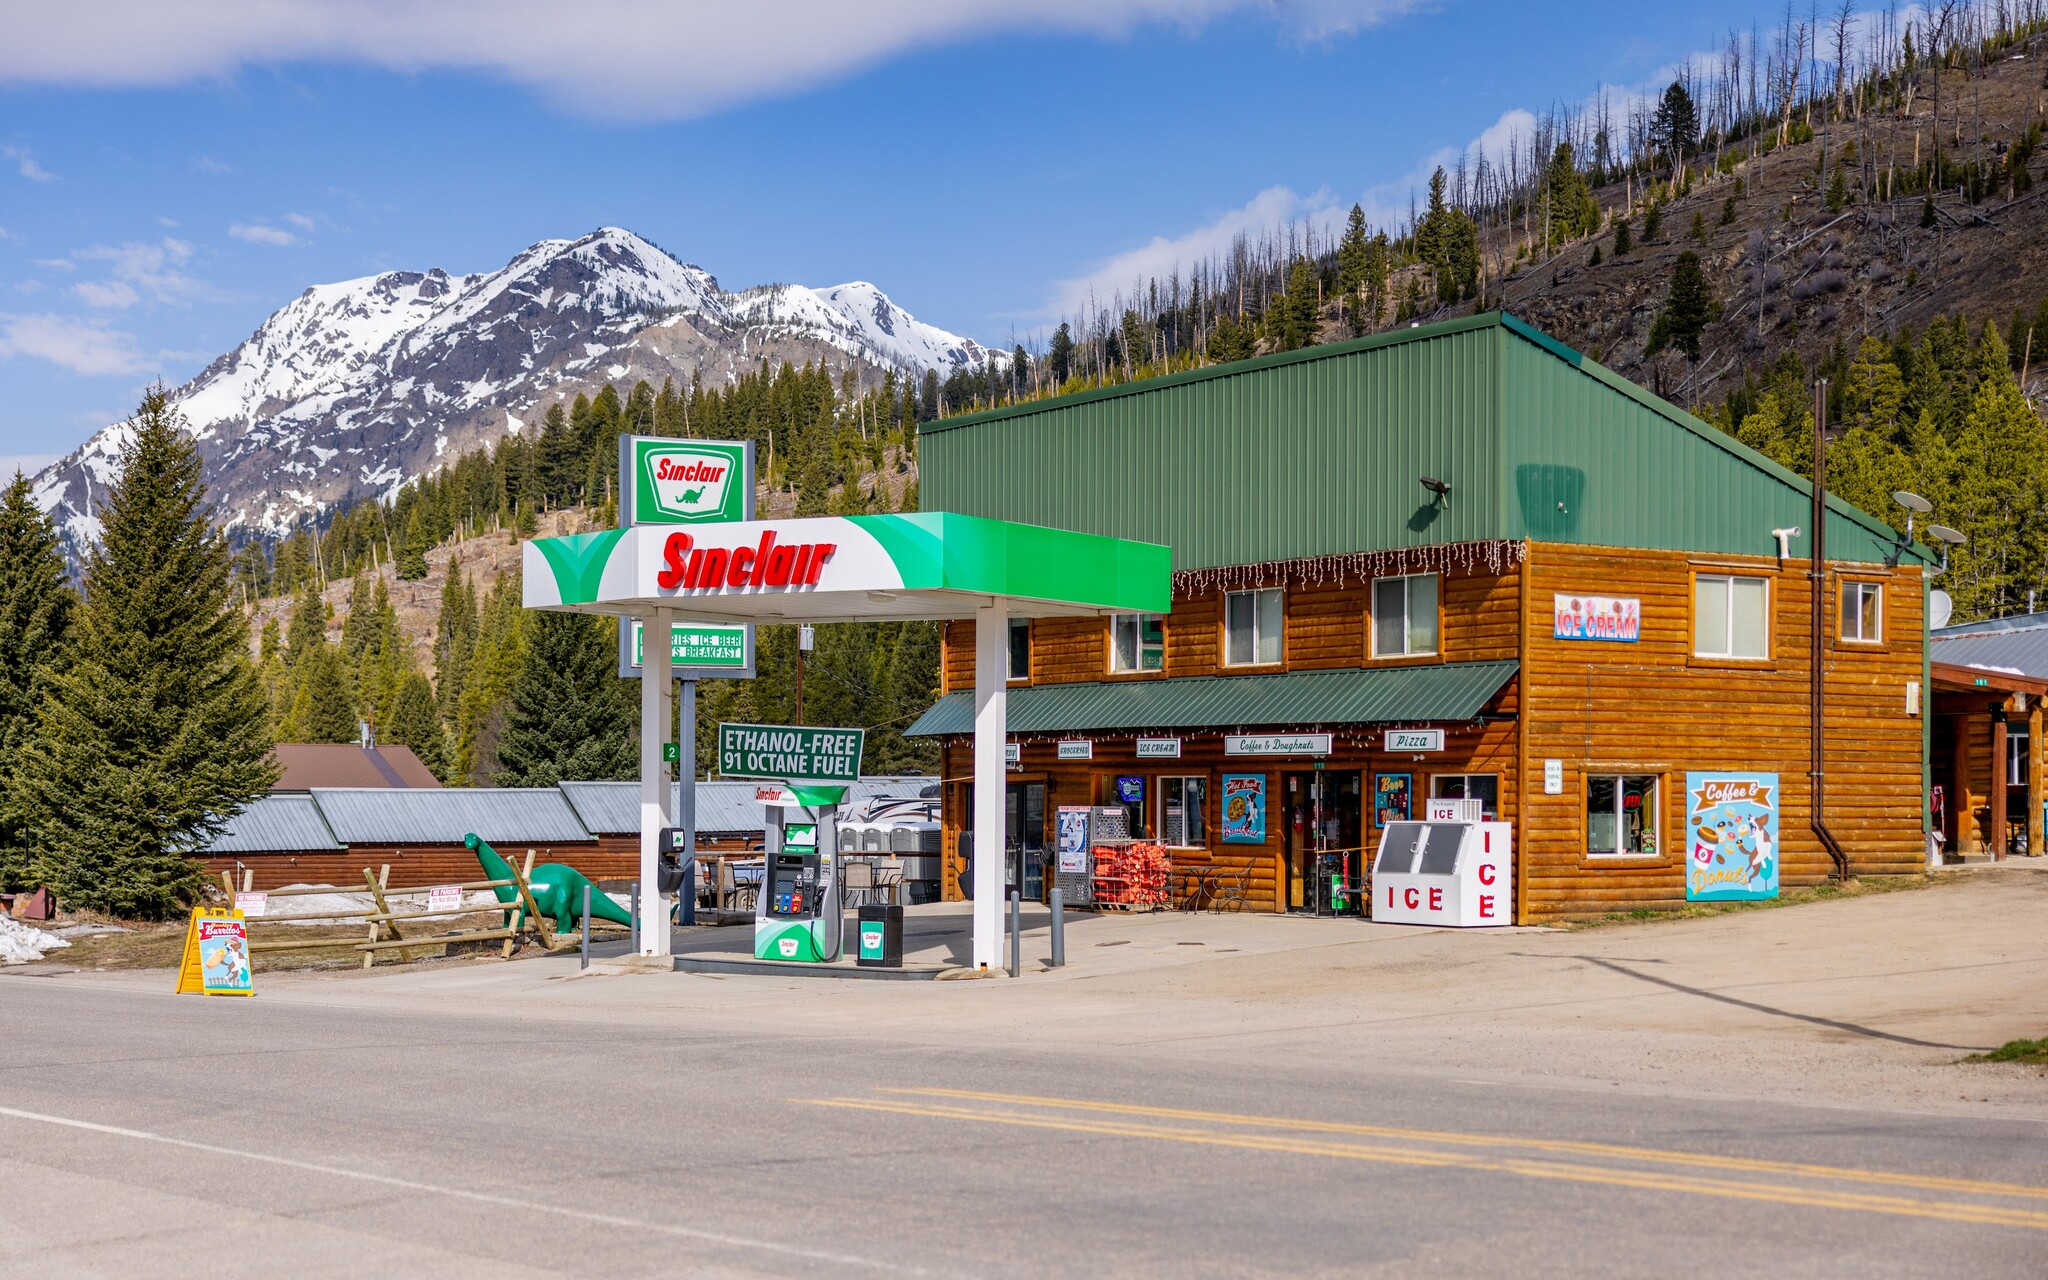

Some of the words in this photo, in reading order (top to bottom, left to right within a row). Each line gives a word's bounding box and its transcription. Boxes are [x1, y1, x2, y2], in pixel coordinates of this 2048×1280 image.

[657, 458, 725, 483] Sinclair
[657, 530, 837, 589] Sinclair
[1556, 613, 1582, 637] ICE
[1585, 615, 1637, 639] CREAM
[699, 635, 713, 646] ICE
[718, 635, 741, 646] BEER
[685, 647, 738, 658] BREAKFAST
[725, 730, 856, 756] ETHANOL-FREE
[1139, 743, 1151, 752] ICE
[1151, 743, 1175, 752] CREAM
[1240, 739, 1262, 751] Coffee
[1264, 739, 1270, 749] &
[1272, 738, 1314, 752] Doughnuts
[1396, 735, 1429, 747] Pizza
[668, 747, 676, 758] 2
[1060, 746, 1089, 755] GROCERIES
[724, 752, 742, 770] 91
[747, 754, 808, 774] OCTANE
[813, 756, 854, 776] FUEL
[1229, 781, 1240, 790] Hot
[1241, 779, 1258, 789] Food
[1381, 777, 1404, 792] Beer
[755, 787, 782, 801] Sinclair
[1706, 783, 1747, 801] Coffee
[1748, 783, 1760, 796] &
[1381, 808, 1406, 821] Wine
[1434, 809, 1454, 819] ICE
[1223, 822, 1259, 840] Breakfast
[1690, 866, 1749, 895] Donuts
[440, 888, 459, 896] PARKING
[1388, 886, 1443, 911] ICE
[205, 925, 241, 936] Burritos
